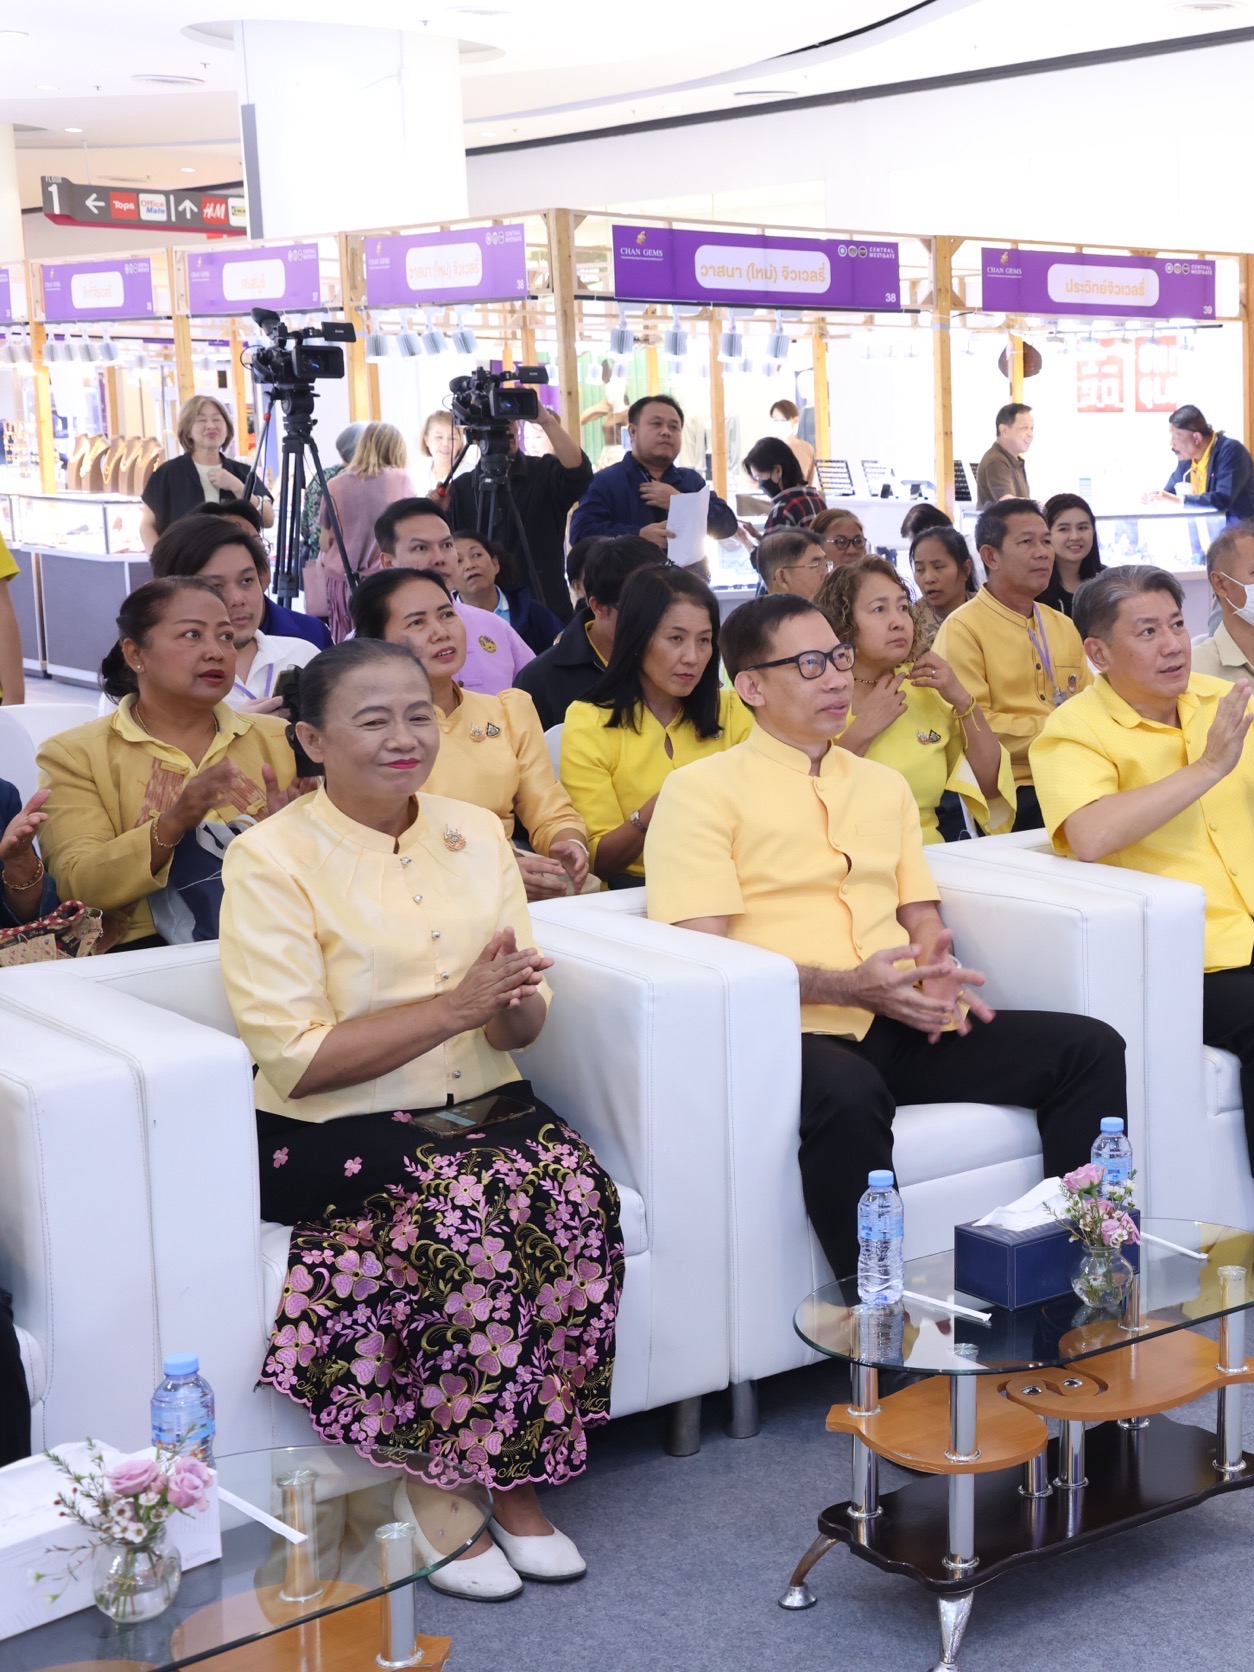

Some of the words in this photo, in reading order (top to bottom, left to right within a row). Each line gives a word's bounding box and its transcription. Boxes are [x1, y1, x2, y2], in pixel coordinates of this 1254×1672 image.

[48, 184, 60, 215] 1
[141, 200, 165, 208] Office
[113, 201, 135, 211] Tops
[146, 207, 166, 215] Mate
[203, 202, 226, 220] H&M
[620, 247, 641, 256] CHAN
[642, 249, 663, 257] GEMS
[700, 264, 742, 278] วาสนา
[746, 262, 778, 284] (ใหม่)
[782, 262, 826, 283] จิวเวลรี่
[986, 266, 1004, 274] CHAN
[1005, 267, 1022, 275] GEMS
[885, 292, 896, 303] 38
[1203, 305, 1213, 315] 39
